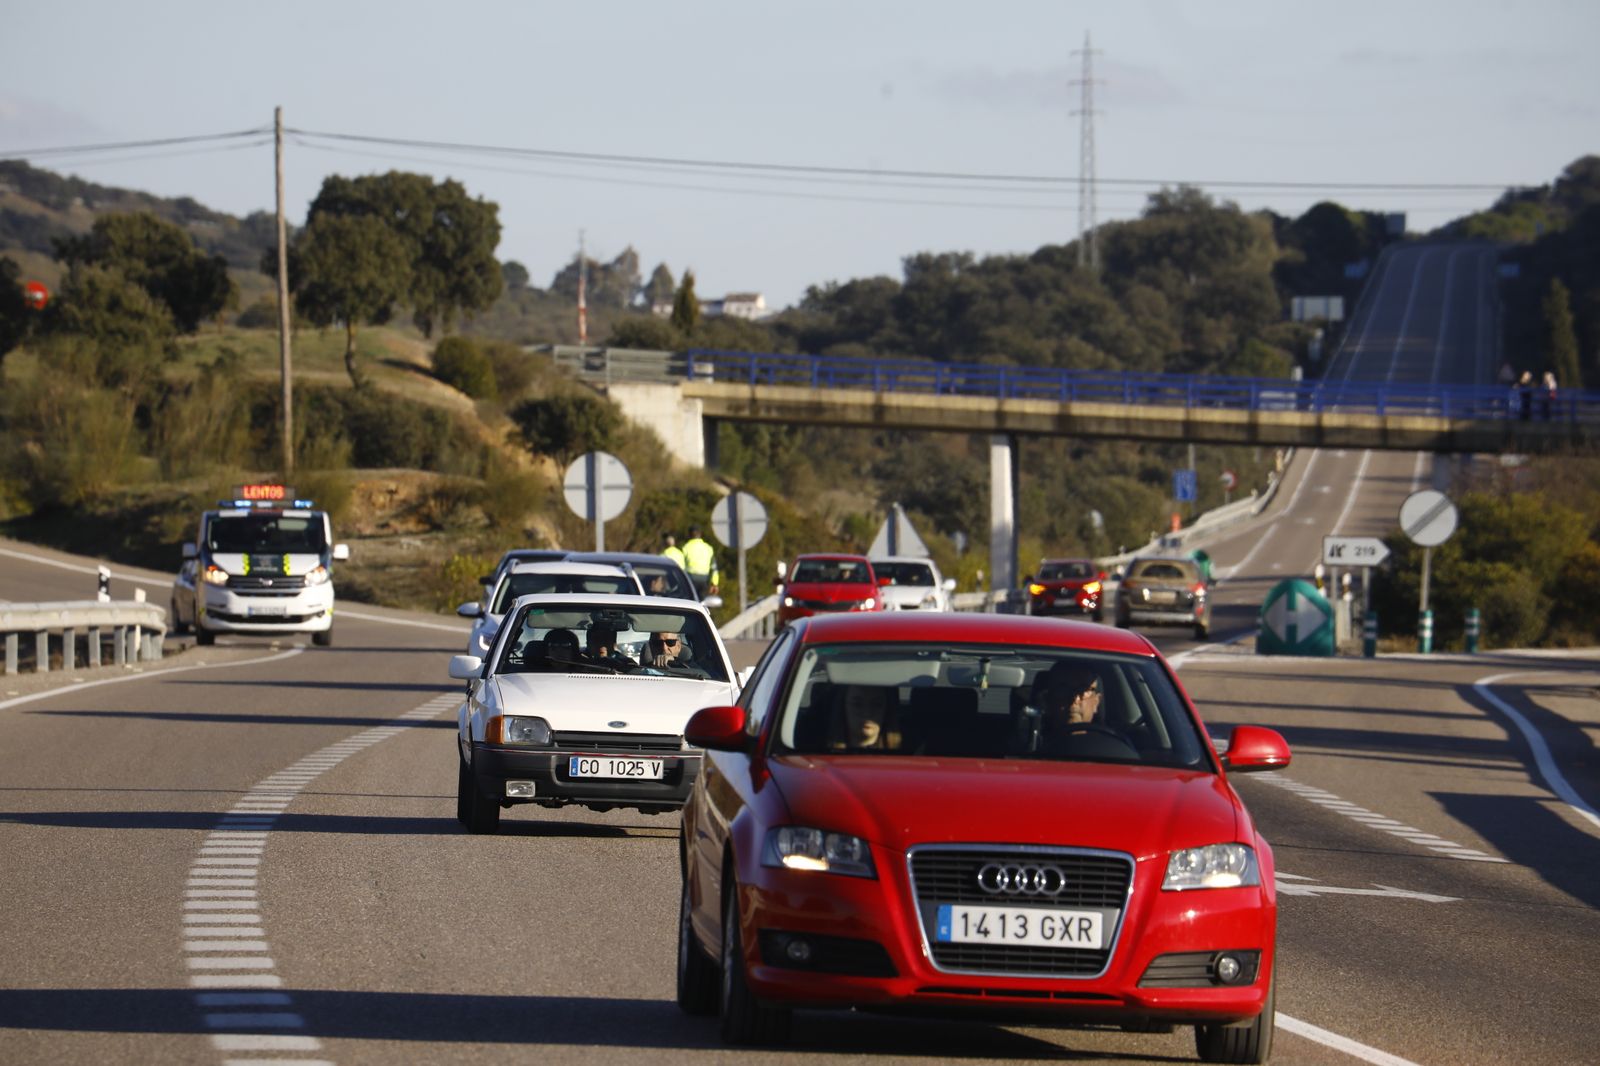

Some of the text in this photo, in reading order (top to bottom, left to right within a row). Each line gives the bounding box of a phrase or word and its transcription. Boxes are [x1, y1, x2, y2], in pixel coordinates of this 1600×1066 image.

[243, 485, 284, 499] LENTOS
[579, 759, 600, 775] CO
[609, 760, 645, 776] 1025
[651, 761, 661, 777] V
[961, 912, 1093, 942] 1413 GXR
